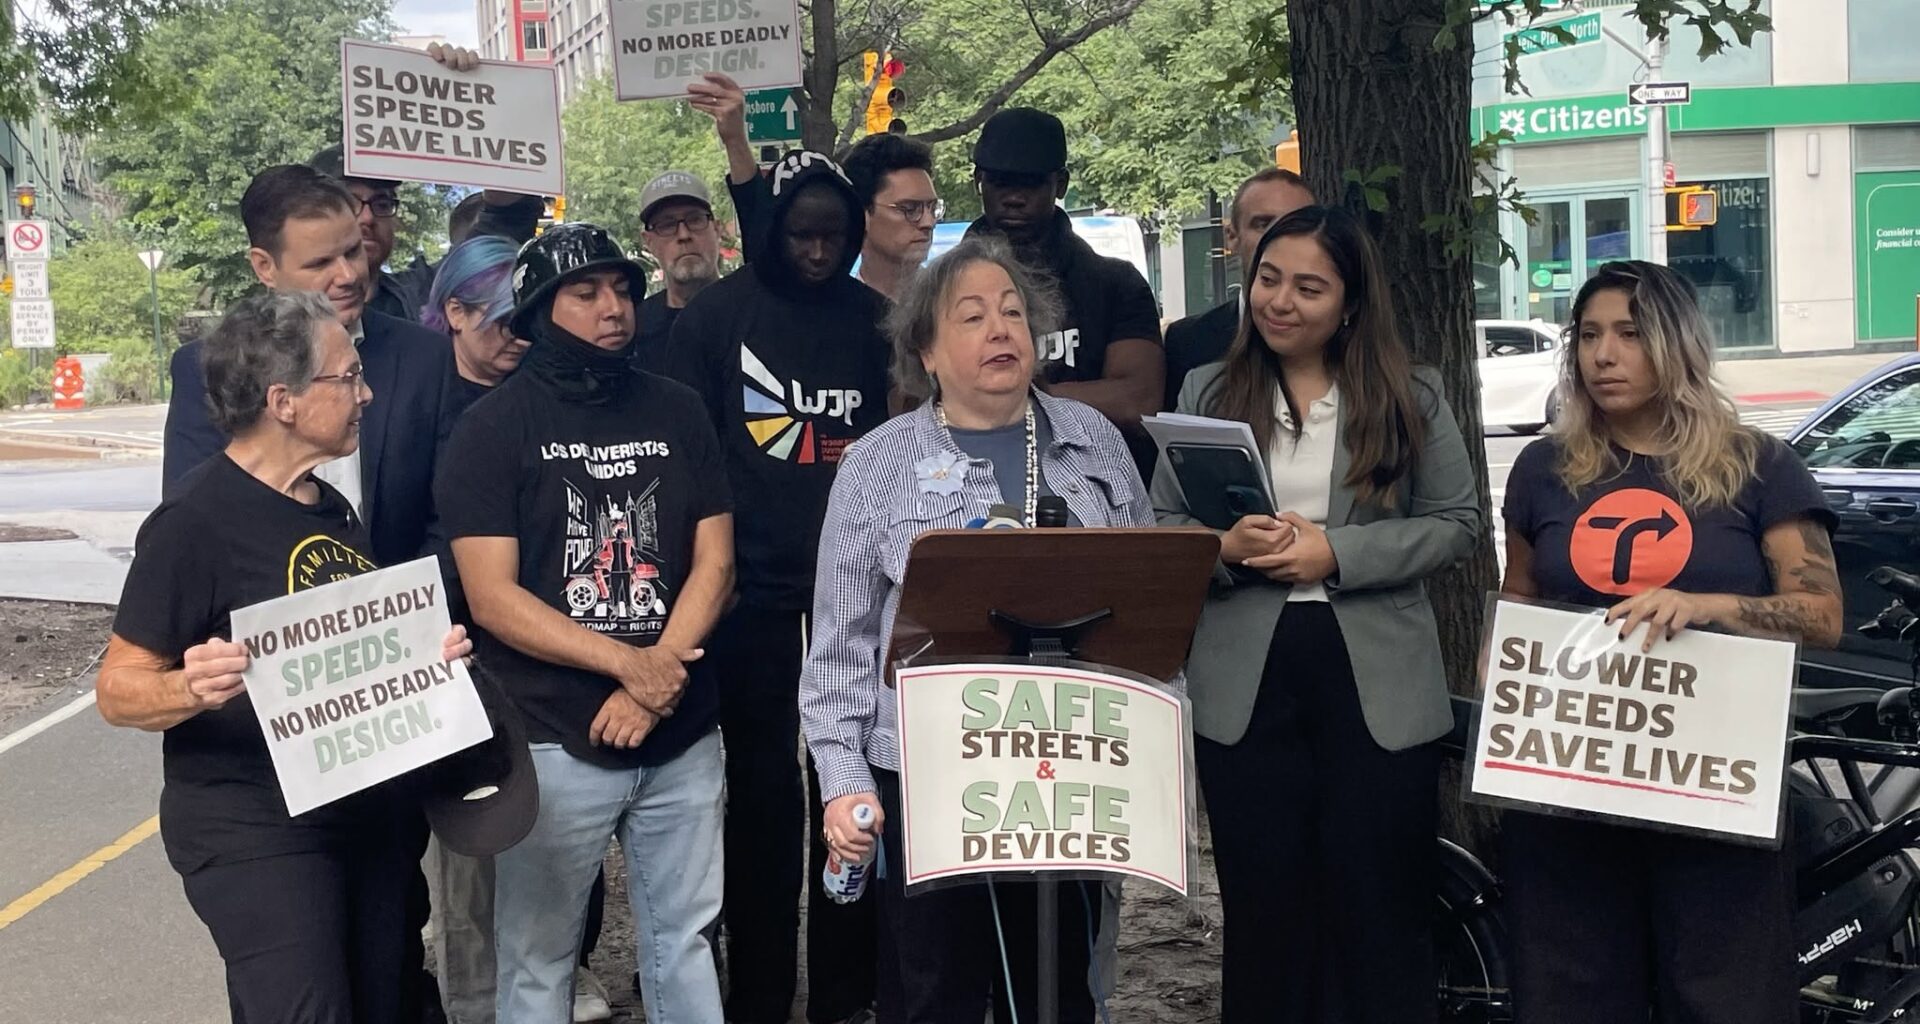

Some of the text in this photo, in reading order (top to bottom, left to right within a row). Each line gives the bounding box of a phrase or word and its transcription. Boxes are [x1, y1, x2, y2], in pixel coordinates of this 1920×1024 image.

[646, 0, 760, 28] SPEEDS.
[1570, 18, 1599, 39] North
[622, 24, 791, 54] NO MORE DEADLY
[654, 46, 766, 79] DESIGN.
[353, 65, 496, 105] SLOWER
[1638, 89, 1682, 99] ONE WAY
[354, 94, 486, 131] SPEEDS
[1530, 105, 1647, 133] Citizens
[355, 124, 547, 166] SAVE LIVES
[1874, 238, 1912, 251] financial
[1876, 227, 1913, 237] Consider
[20, 288, 43, 296] TONS
[16, 312, 49, 320] SERVICE
[791, 379, 863, 427] WJP
[541, 442, 569, 460] LOS
[300, 545, 367, 588] FAMILIE
[244, 583, 435, 660] NO MORE DEADLY
[281, 627, 412, 697] SPEEDS.
[1499, 637, 1698, 698] SLOWER
[270, 660, 455, 742] NO MORE DEADLY
[961, 678, 1129, 740] SAFE
[1493, 680, 1676, 738] SPEEDS
[313, 699, 442, 774] DESIGN.
[962, 730, 1130, 767] STREETS
[1036, 760, 1056, 779] &
[1487, 723, 1757, 795] SAVE LIVES
[962, 781, 1130, 837] SAFE
[963, 832, 1131, 863] DEVICES
[837, 864, 865, 896] hint
